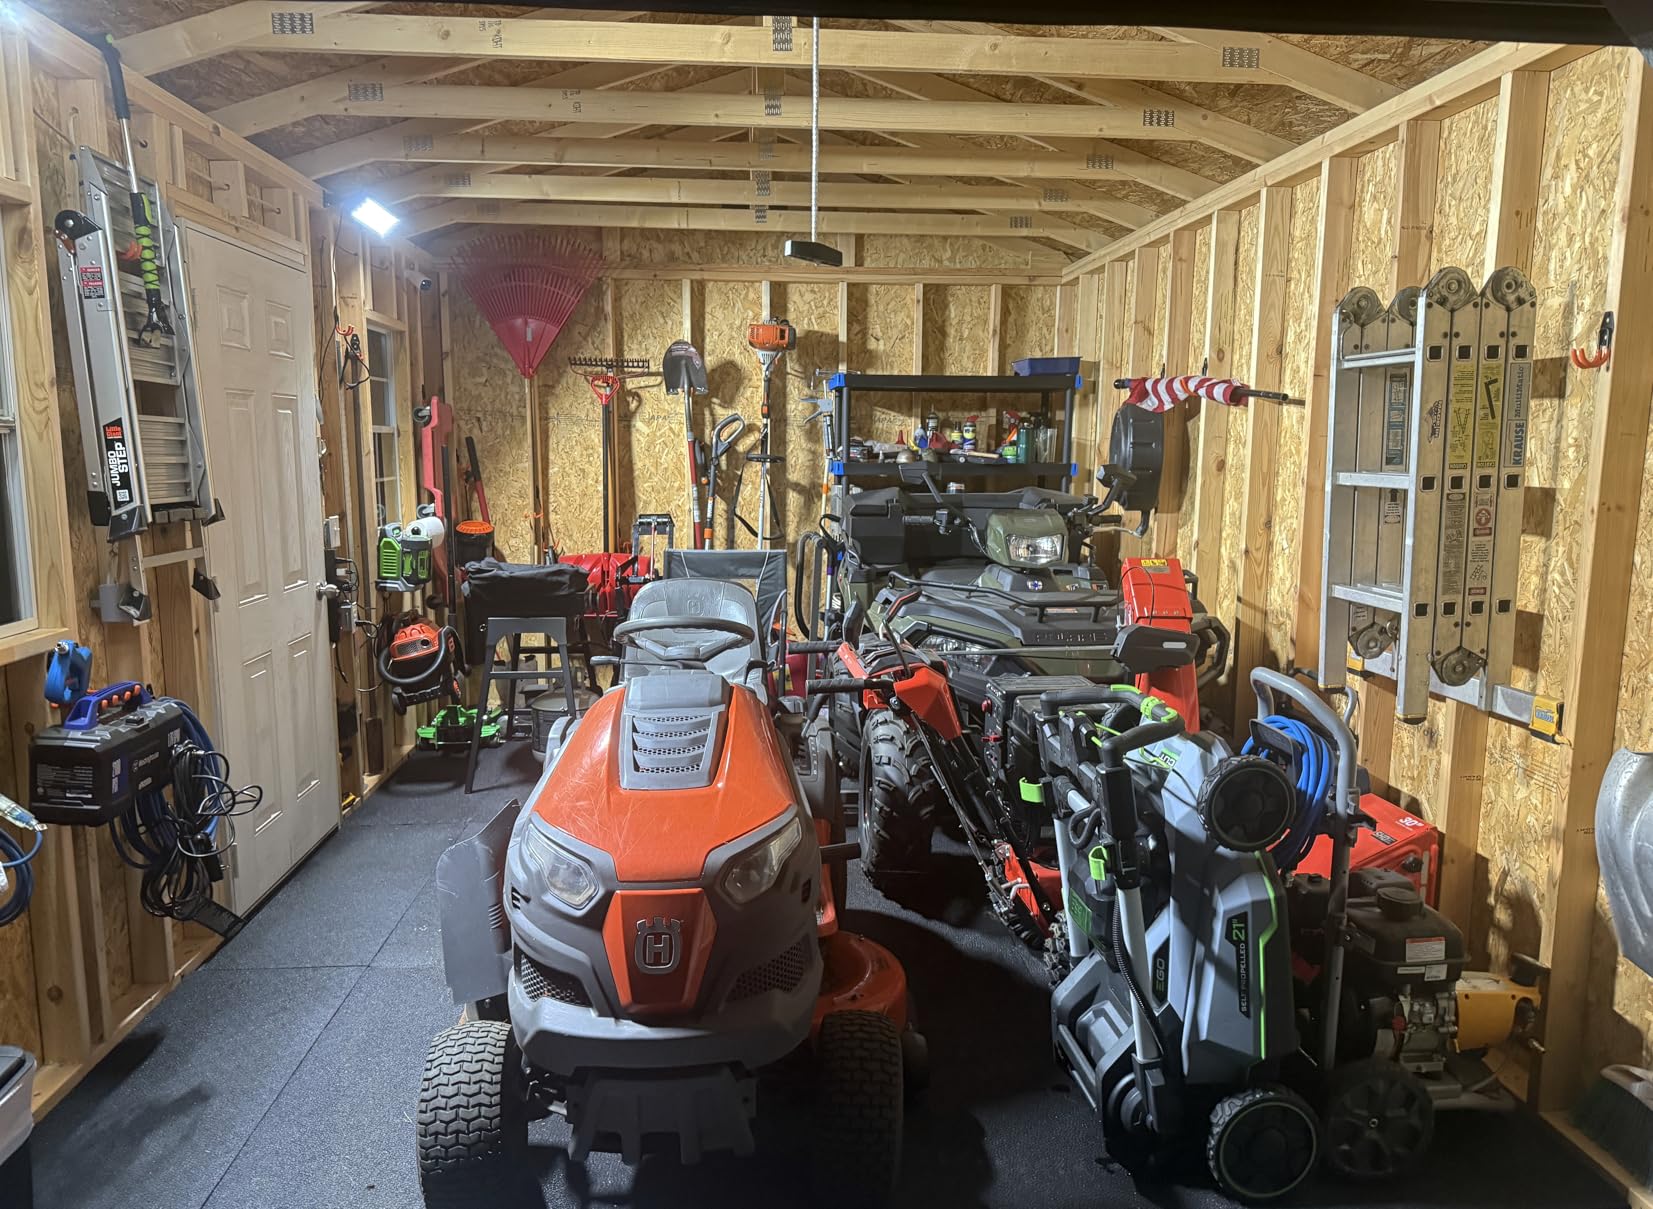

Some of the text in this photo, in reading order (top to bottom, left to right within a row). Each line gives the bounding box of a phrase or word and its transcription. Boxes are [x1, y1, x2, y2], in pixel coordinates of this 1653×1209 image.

[115, 442, 129, 473] STEP
[1512, 422, 1524, 465] KRAUSE
[108, 451, 120, 486] JUMBO
[646, 935, 670, 964] H
[1156, 958, 1165, 992] EGO
